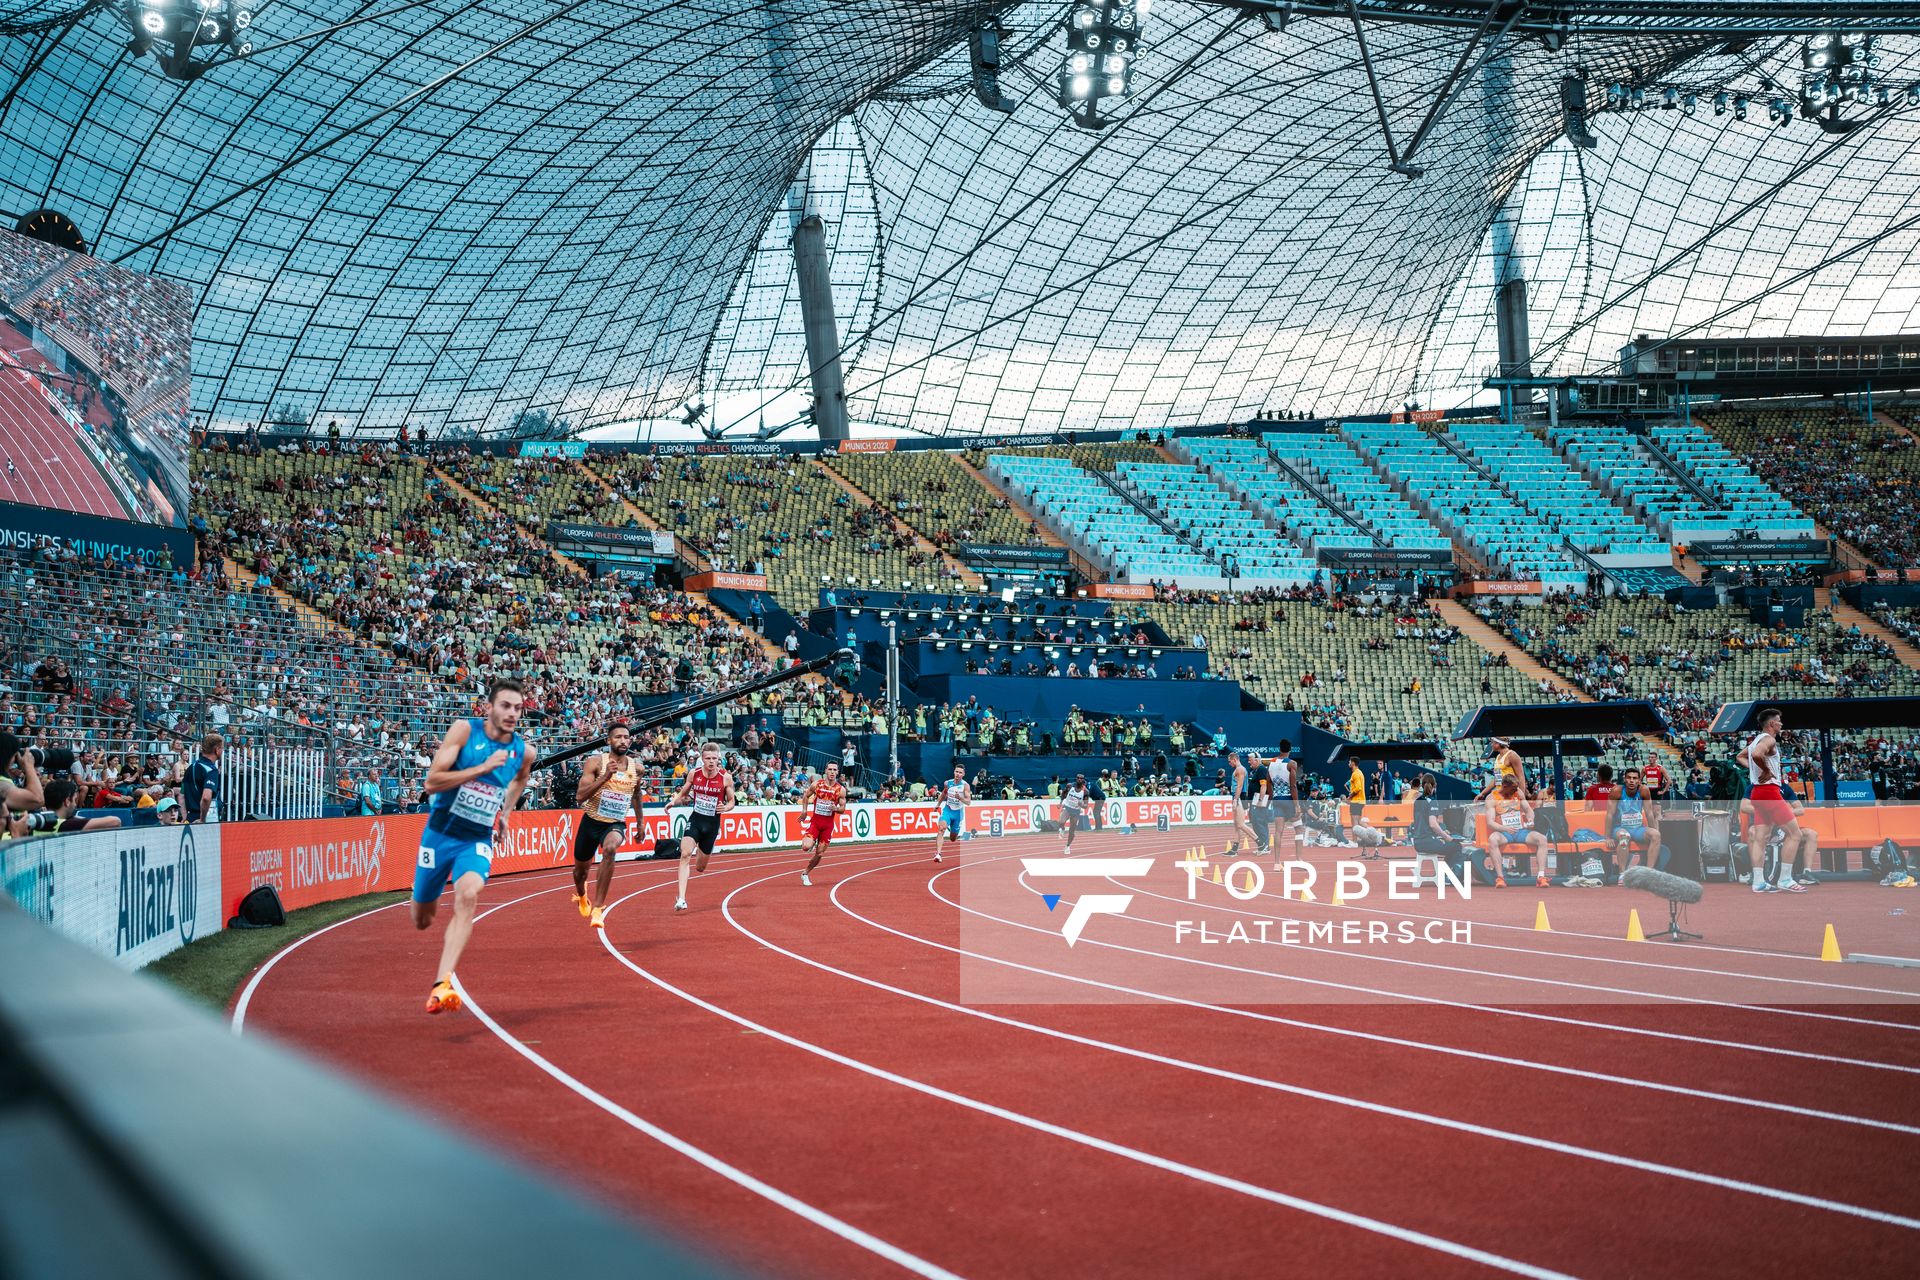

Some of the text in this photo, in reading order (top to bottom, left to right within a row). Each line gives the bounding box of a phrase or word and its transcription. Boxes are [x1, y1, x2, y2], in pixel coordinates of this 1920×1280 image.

[845, 442, 889, 450] MUNICH 2022
[963, 435, 1053, 447] EURPEAN CHAMPIONSHIPS
[560, 445, 579, 455] 022
[696, 444, 731, 453] ATHLETICS
[732, 444, 780, 453] CHAMPIONSHIPS
[564, 528, 594, 538] EUROPEAN
[594, 530, 622, 540] ATHLETICS
[623, 533, 653, 543] CHAMPIONS
[967, 547, 990, 555] EUROPEAN
[997, 549, 1032, 557] CHAMPIONSHIPS
[717, 575, 763, 587] MUNICH 2022
[1619, 576, 1645, 584] TO
[1105, 587, 1146, 596] MUNICH 2022
[1488, 583, 1512, 591] MUNICH
[693, 784, 721, 793] DENMARK
[1837, 790, 1868, 799] etmaster
[457, 791, 499, 812] SCOTTI
[1139, 804, 1182, 820] SPAR
[1213, 803, 1233, 818] SP
[890, 810, 940, 831] SPAR
[980, 807, 1029, 827] SPAR
[1160, 818, 1165, 827] 7
[621, 820, 670, 846] PAR
[716, 817, 763, 840] PAR
[992, 822, 999, 832] 8
[491, 826, 557, 858] RUN CLEAN
[250, 848, 282, 873] EUROPEAN
[423, 851, 430, 864] 8
[290, 839, 369, 889] I RUN CLEAN
[117, 846, 174, 957] Allianz
